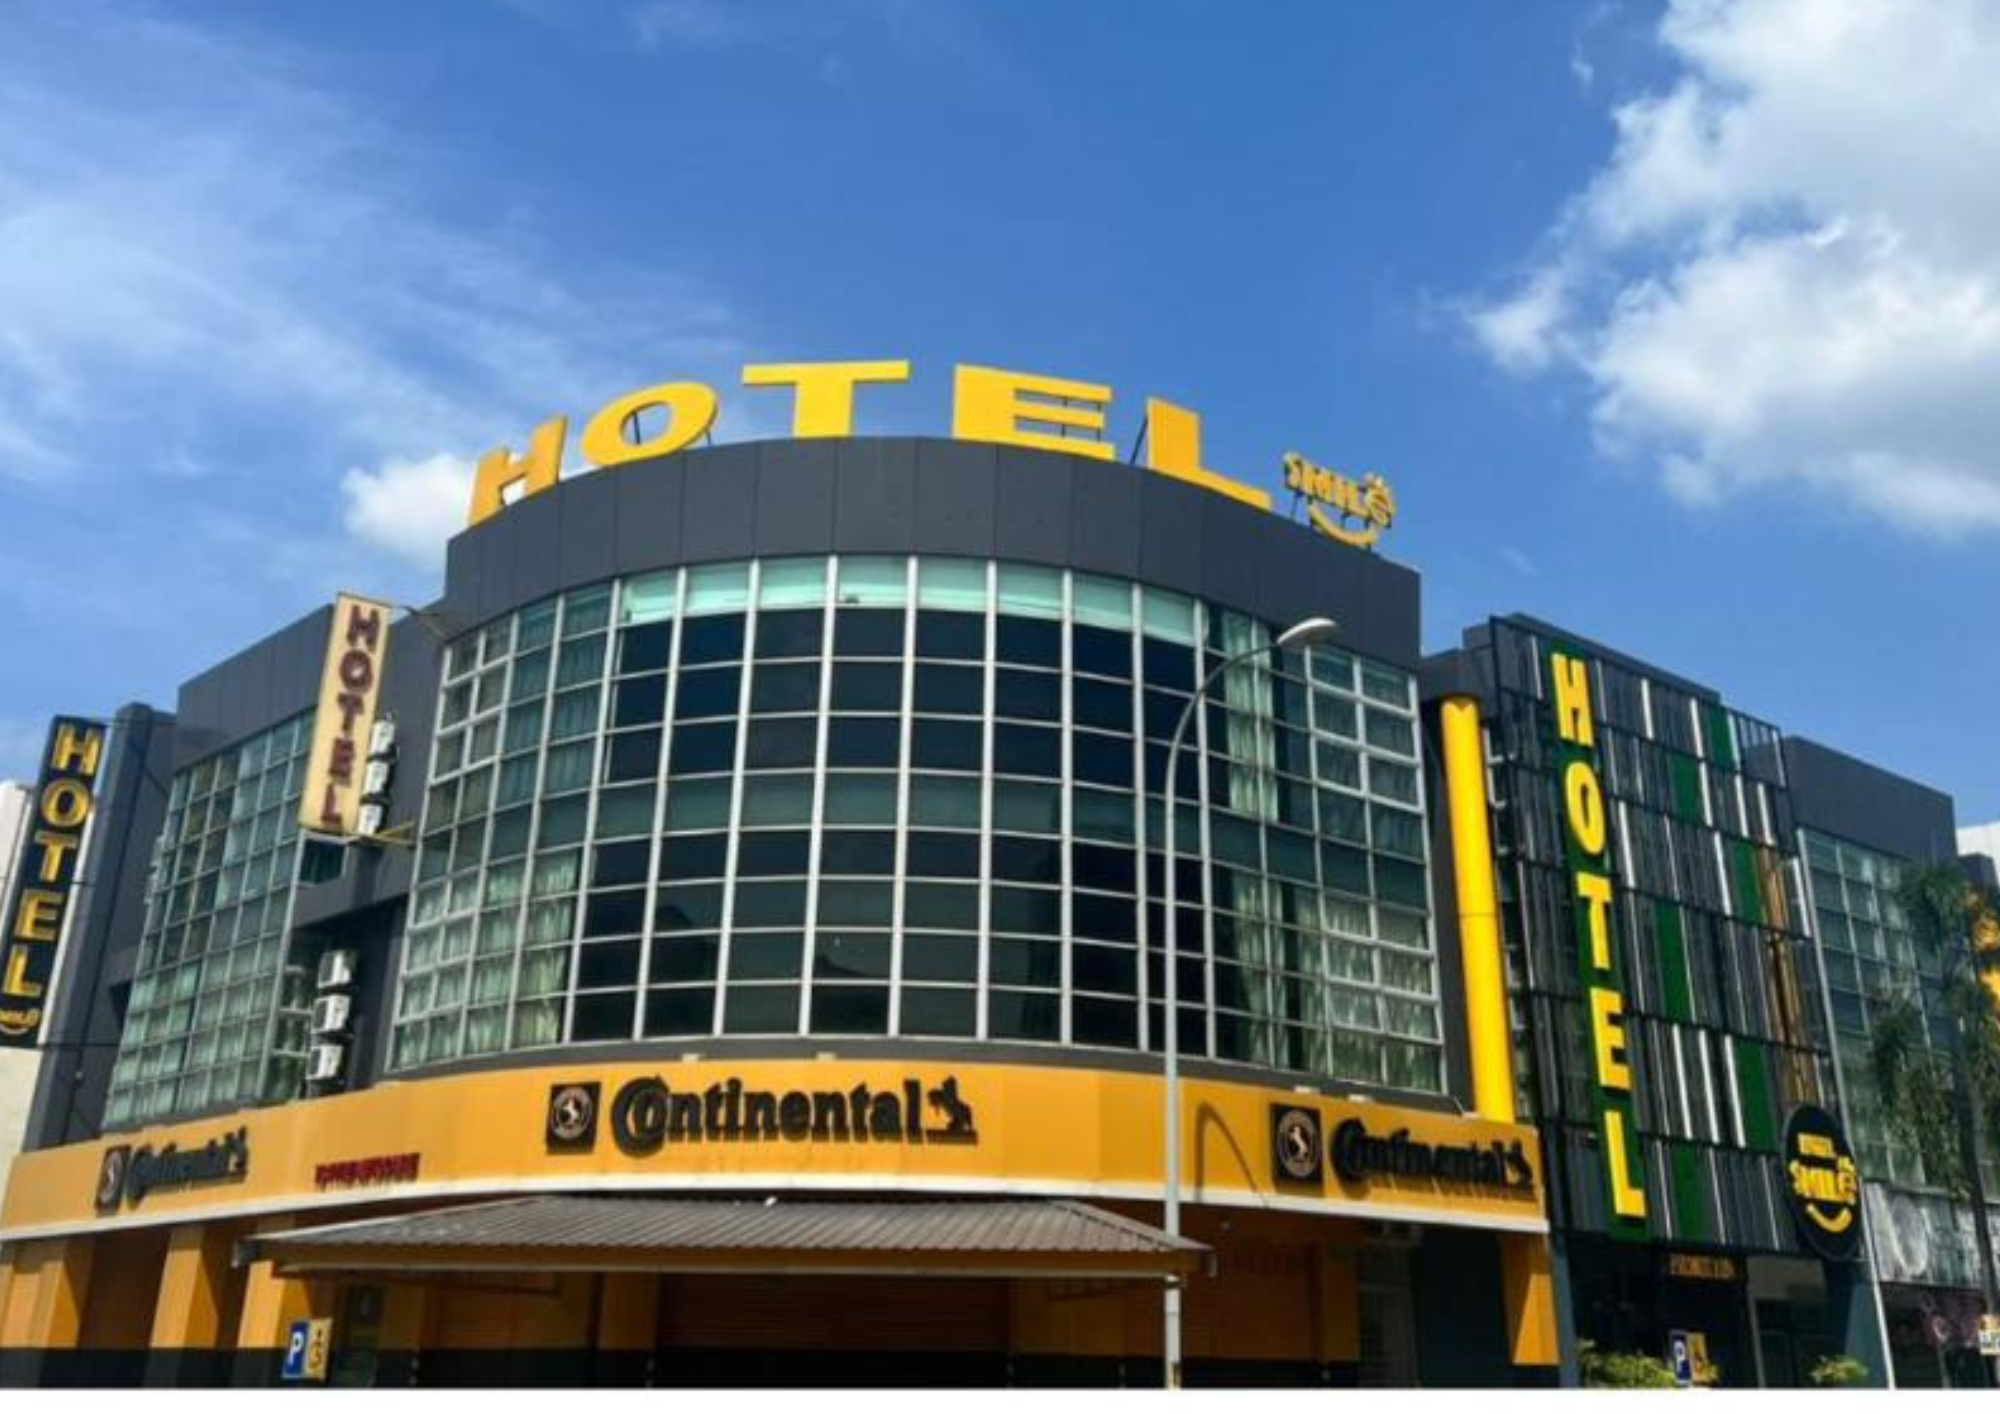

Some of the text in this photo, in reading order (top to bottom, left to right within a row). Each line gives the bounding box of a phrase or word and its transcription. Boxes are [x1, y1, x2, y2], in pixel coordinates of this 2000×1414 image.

[468, 360, 1273, 526] HOTEL
[320, 604, 379, 826] HOTEL
[2, 723, 100, 997] HOTEL
[1552, 653, 1646, 1216] HOTEL
[611, 1074, 925, 1158] Continental
[287, 1331, 304, 1366] P
